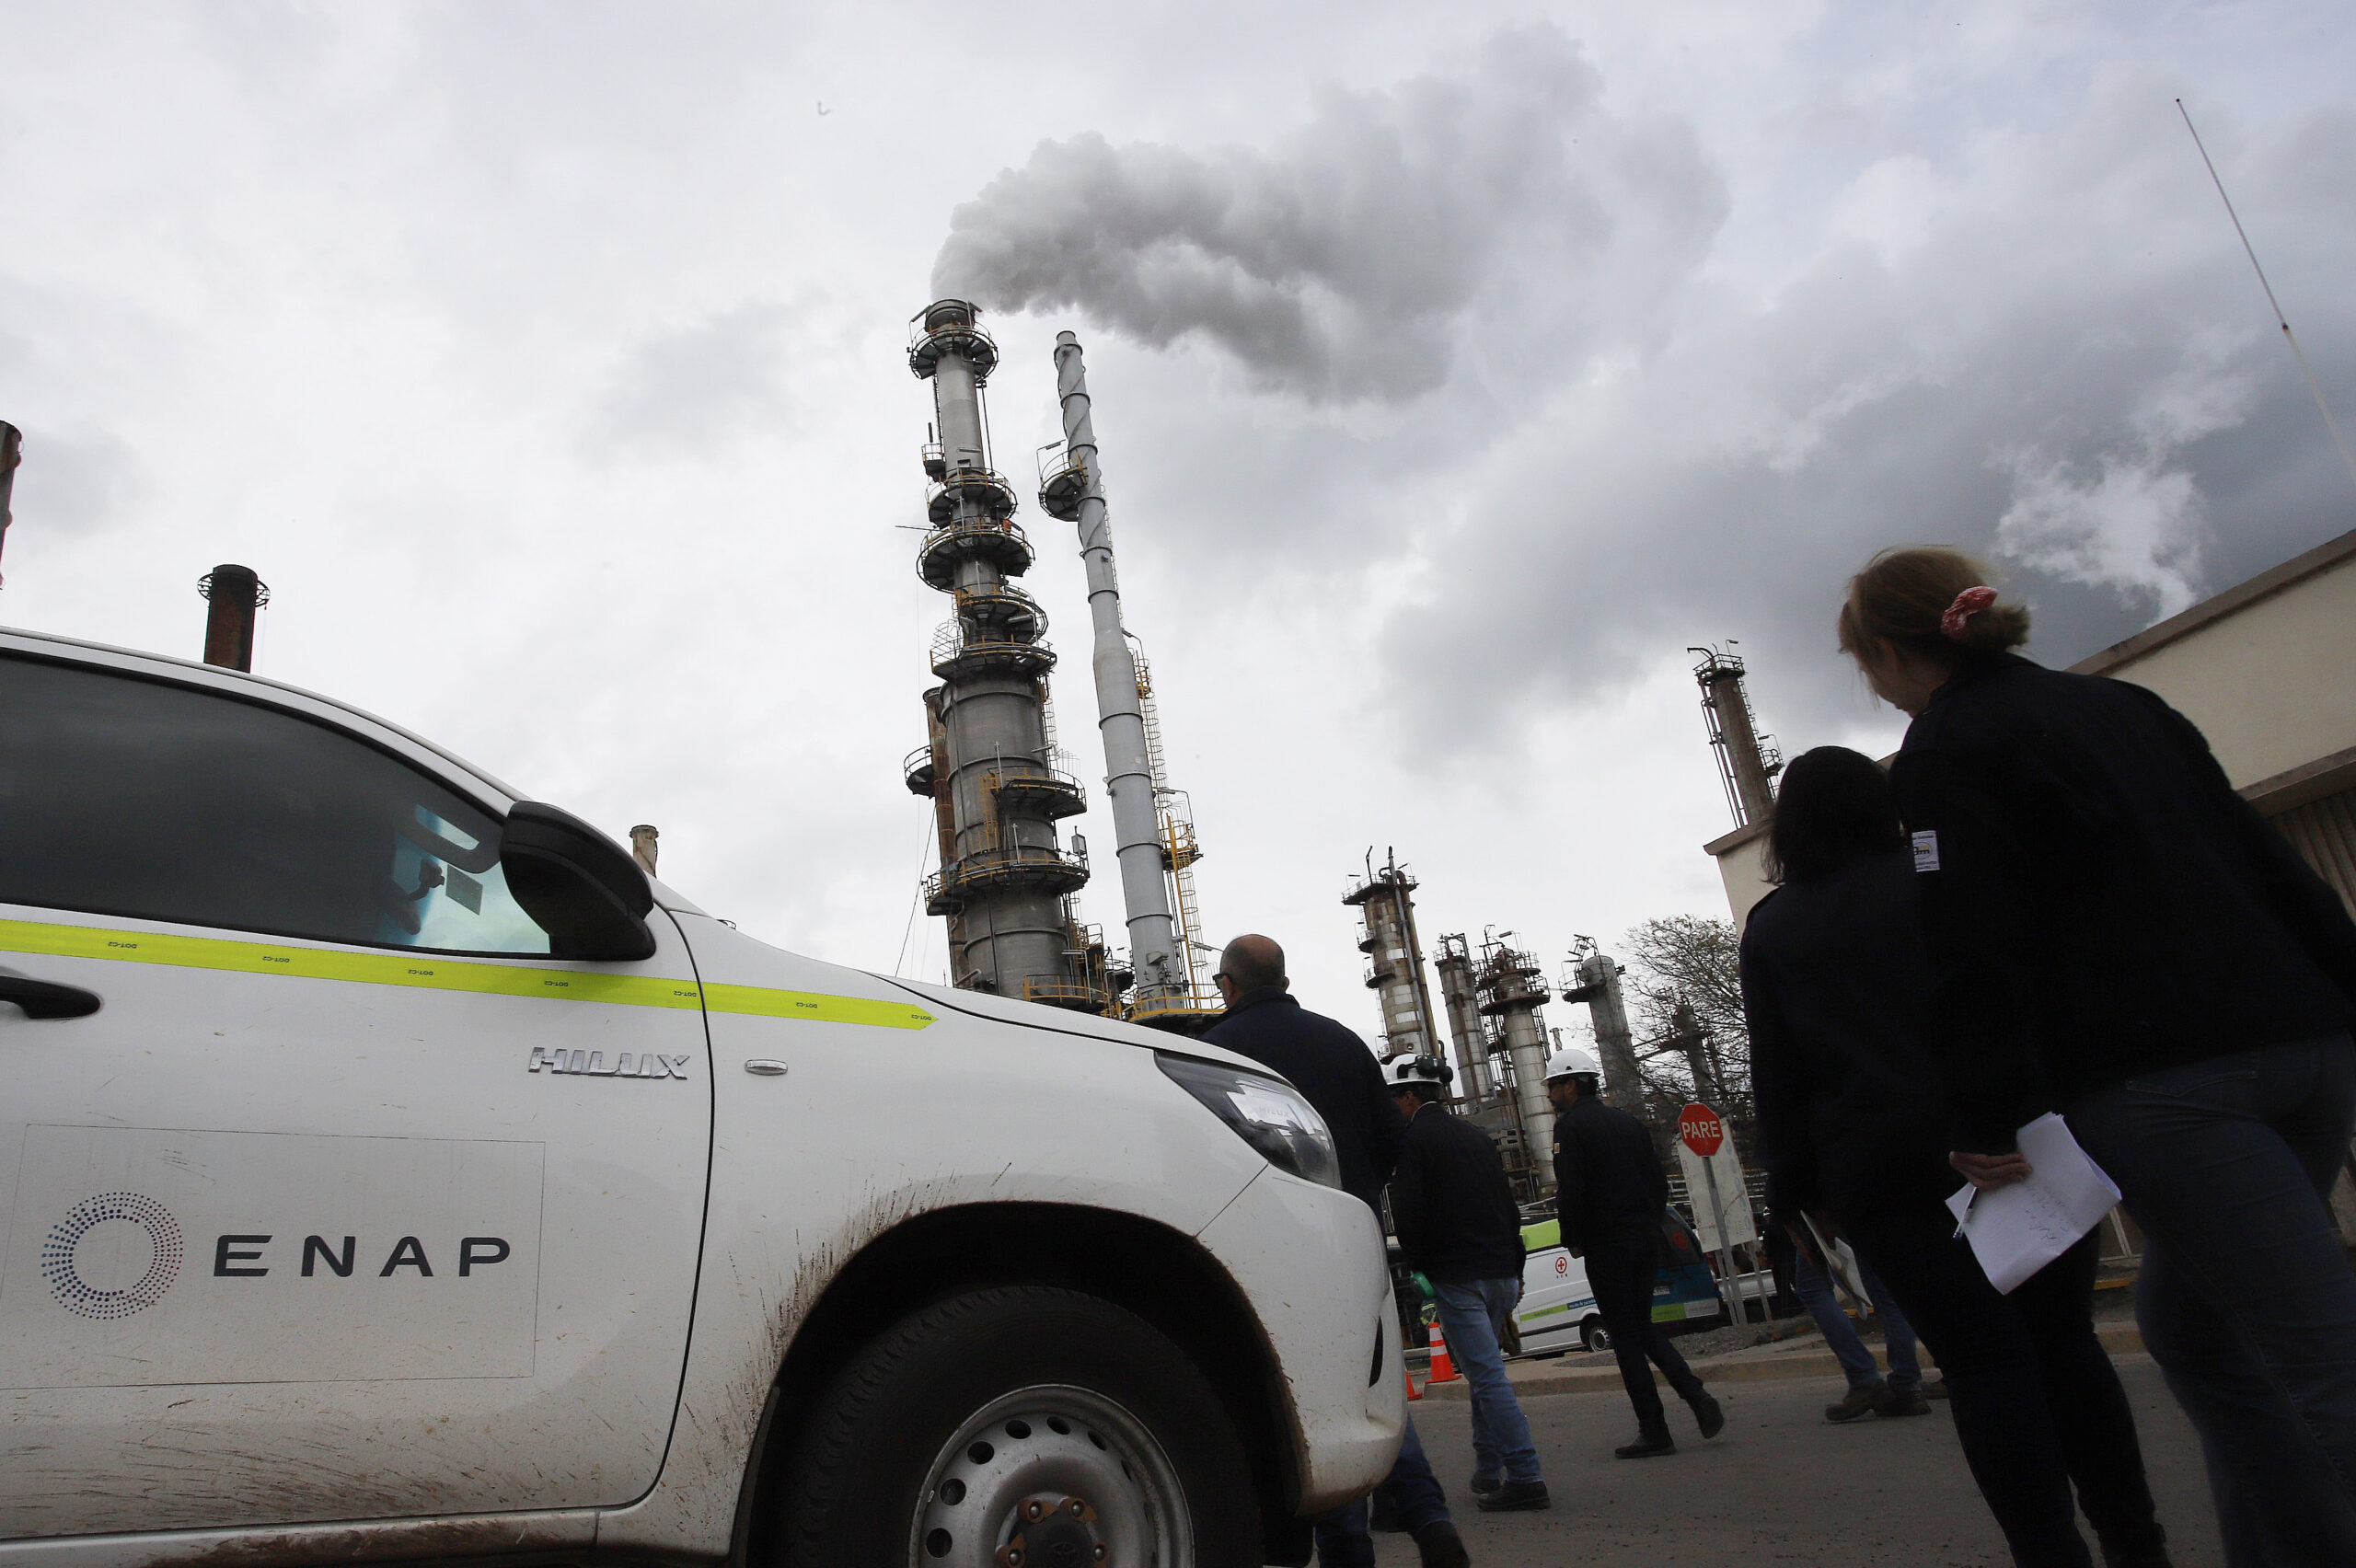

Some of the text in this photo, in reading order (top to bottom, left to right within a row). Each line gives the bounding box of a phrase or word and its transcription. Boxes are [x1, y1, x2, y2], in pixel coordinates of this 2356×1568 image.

[528, 1046, 690, 1080] HILUX
[1681, 1120, 1721, 1139] PARE
[213, 1234, 512, 1278] ENAP
